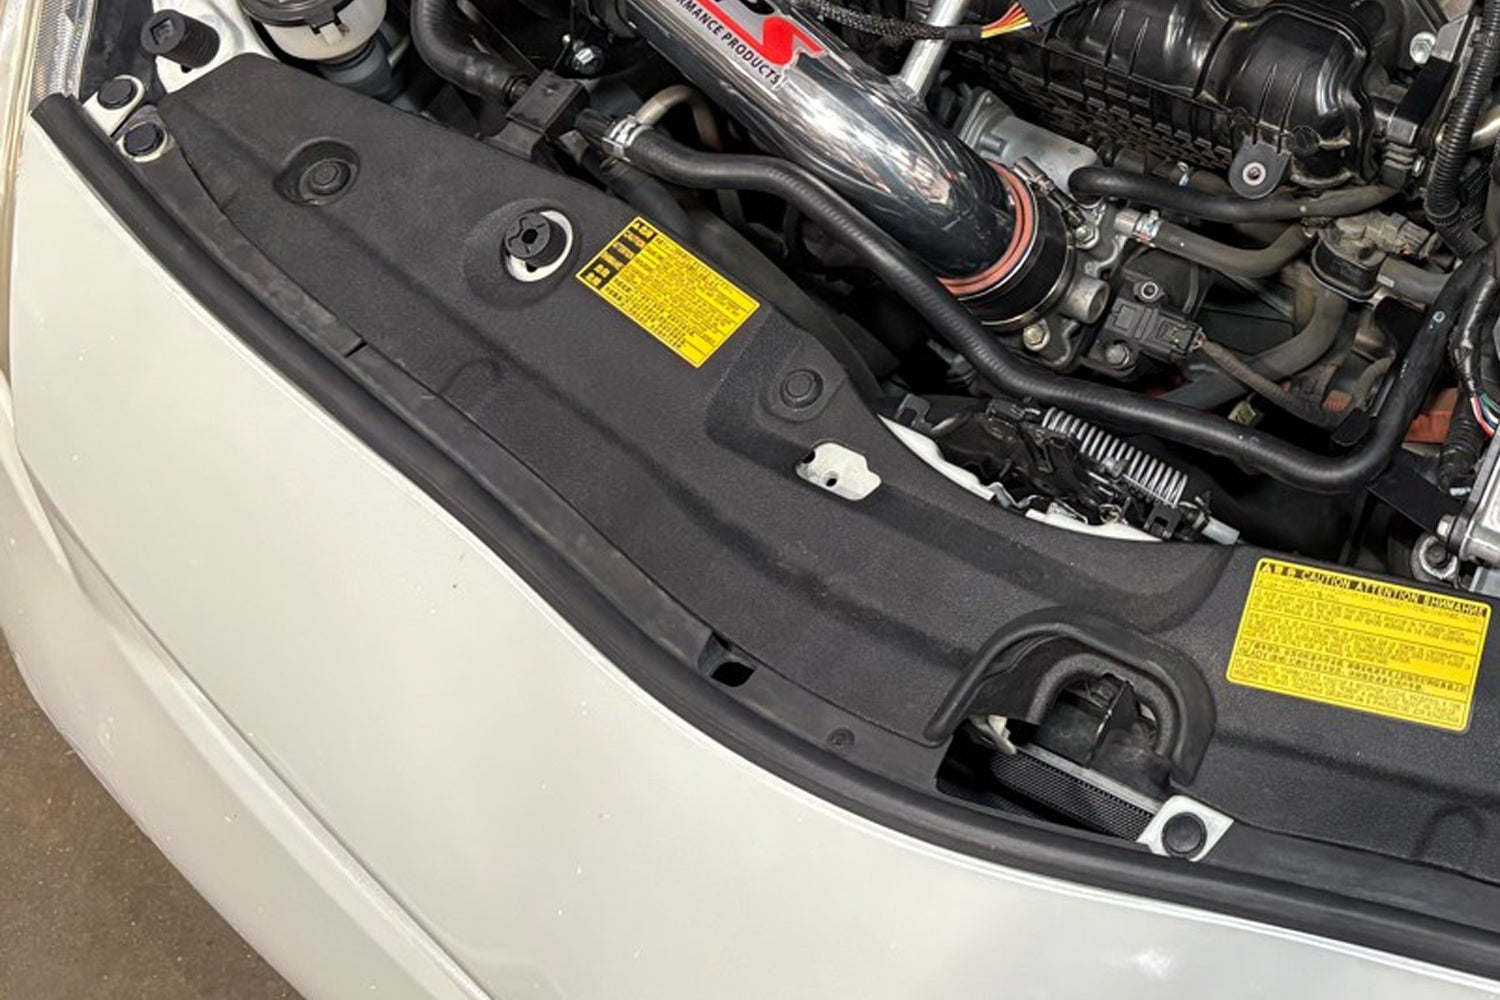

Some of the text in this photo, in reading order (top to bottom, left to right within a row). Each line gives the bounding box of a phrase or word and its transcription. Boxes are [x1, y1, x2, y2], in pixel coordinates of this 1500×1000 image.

[720, 32, 781, 87] PRODUCTS
[1300, 571, 1351, 590] CAUTION
[1356, 580, 1419, 604] ATTENTION
